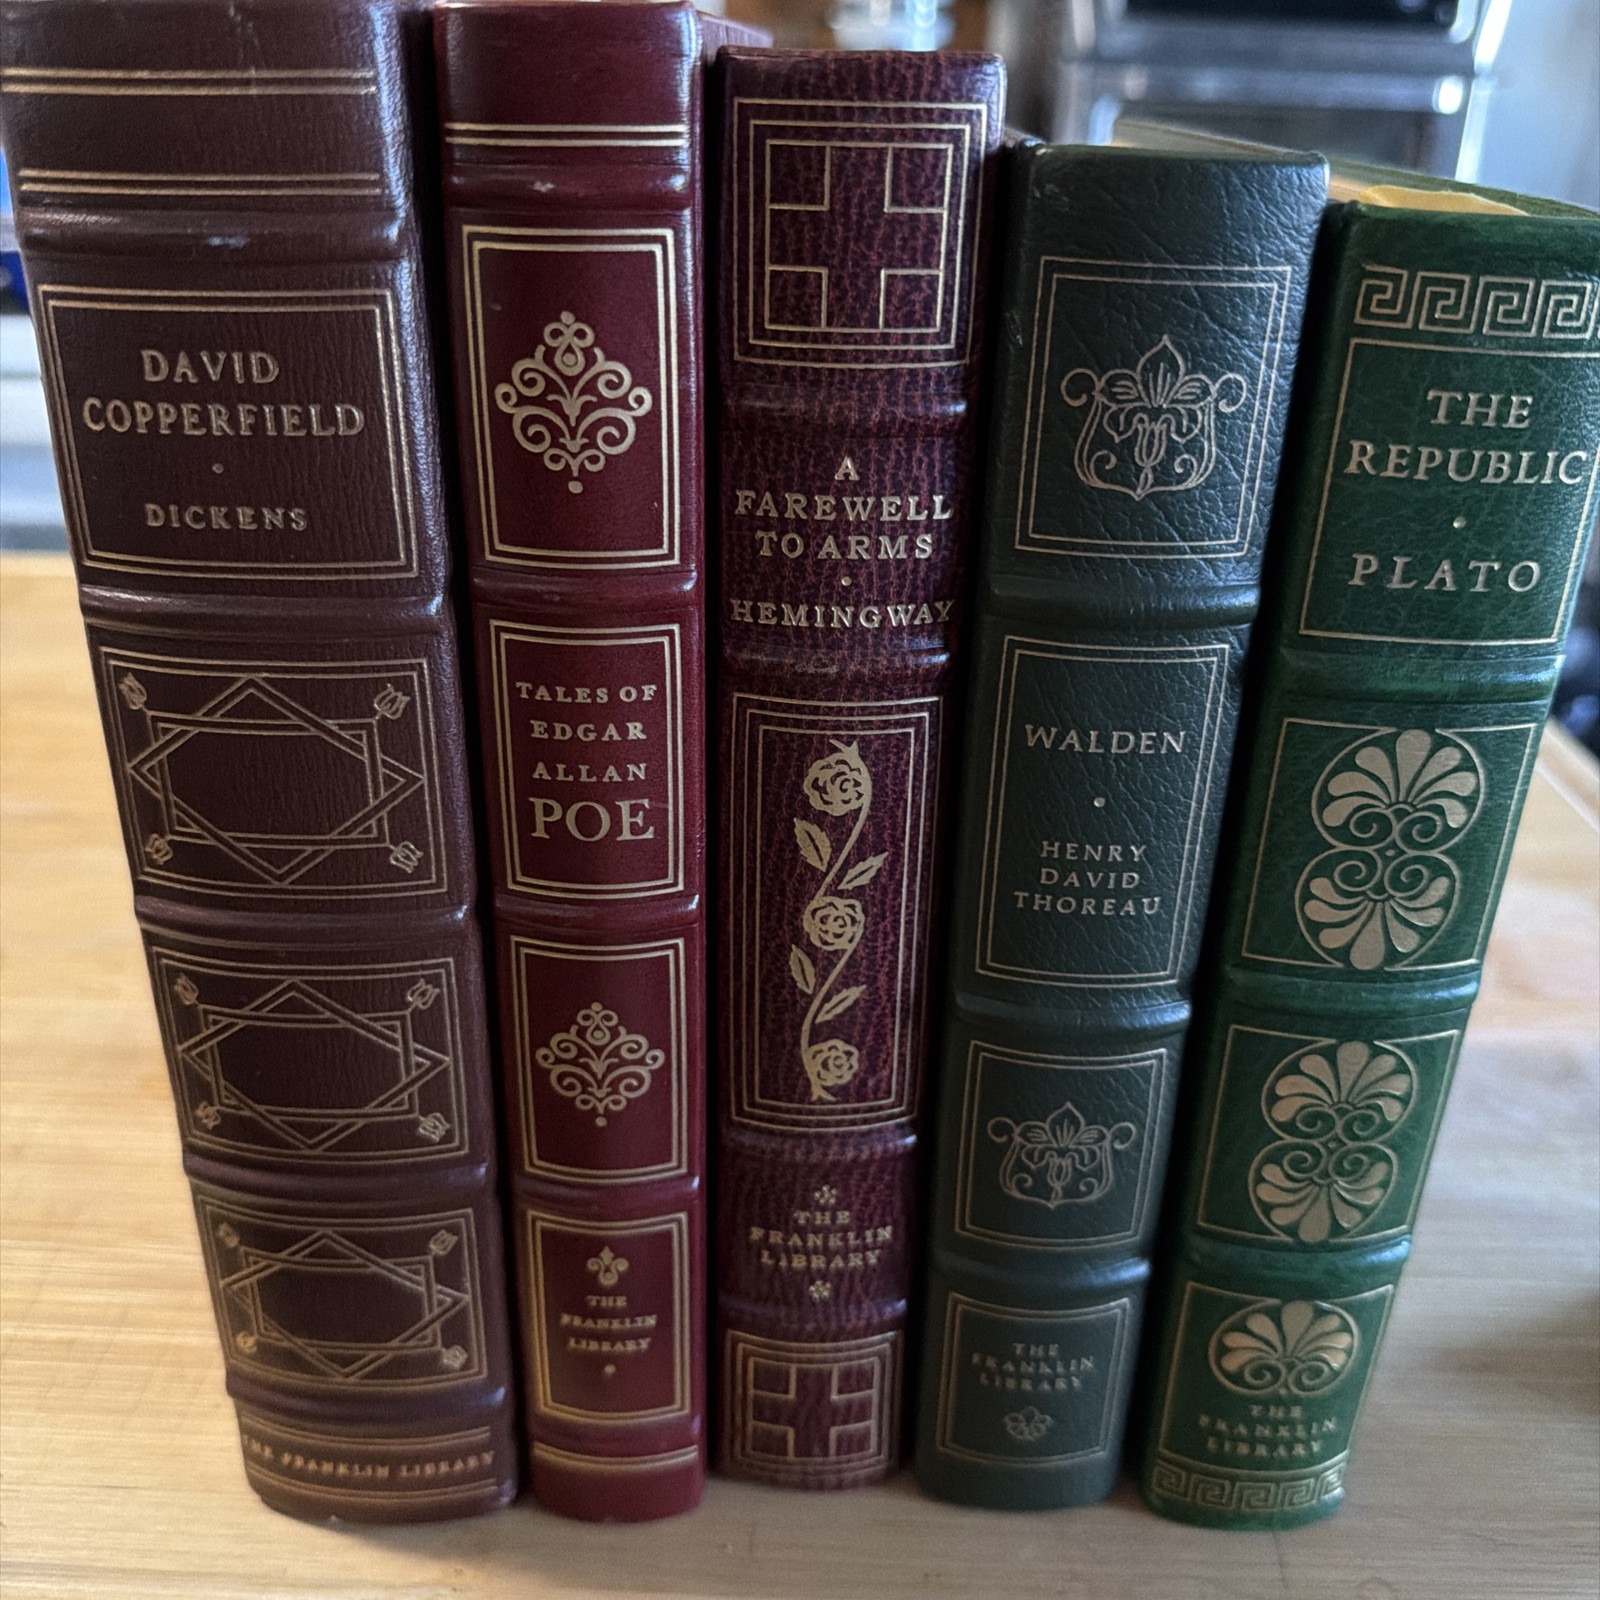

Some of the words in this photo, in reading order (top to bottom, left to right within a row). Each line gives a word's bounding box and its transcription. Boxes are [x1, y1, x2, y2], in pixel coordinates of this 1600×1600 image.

[141, 349, 280, 384] DAVID
[83, 396, 365, 437] COPPERFIELD
[1426, 388, 1534, 429] THE
[834, 454, 861, 481] A
[1343, 439, 1588, 486] REPUBLIC
[143, 503, 308, 531] DICKENS
[734, 488, 954, 522] FAREWELL
[754, 530, 805, 559] TO
[817, 533, 933, 560] ARMS
[1347, 552, 1542, 593] PLATO
[730, 599, 955, 629] HEMINGWAY
[515, 681, 609, 704] TALES
[619, 684, 658, 703] OF
[529, 719, 648, 742] EDGAR
[1024, 723, 1186, 754] WALDEN
[532, 761, 648, 783] ALLAN
[528, 796, 655, 842] POE
[1040, 840, 1147, 862] HENRY
[1040, 867, 1141, 889] DAVID
[1013, 890, 1161, 916] THOREAU
[793, 1210, 851, 1225] THE
[750, 1225, 894, 1249] FRANKLIN
[760, 1249, 881, 1270] LIBRARY
[586, 1294, 628, 1308] THE
[1012, 1342, 1060, 1358] THE
[971, 1352, 1095, 1375] FRANKLIN
